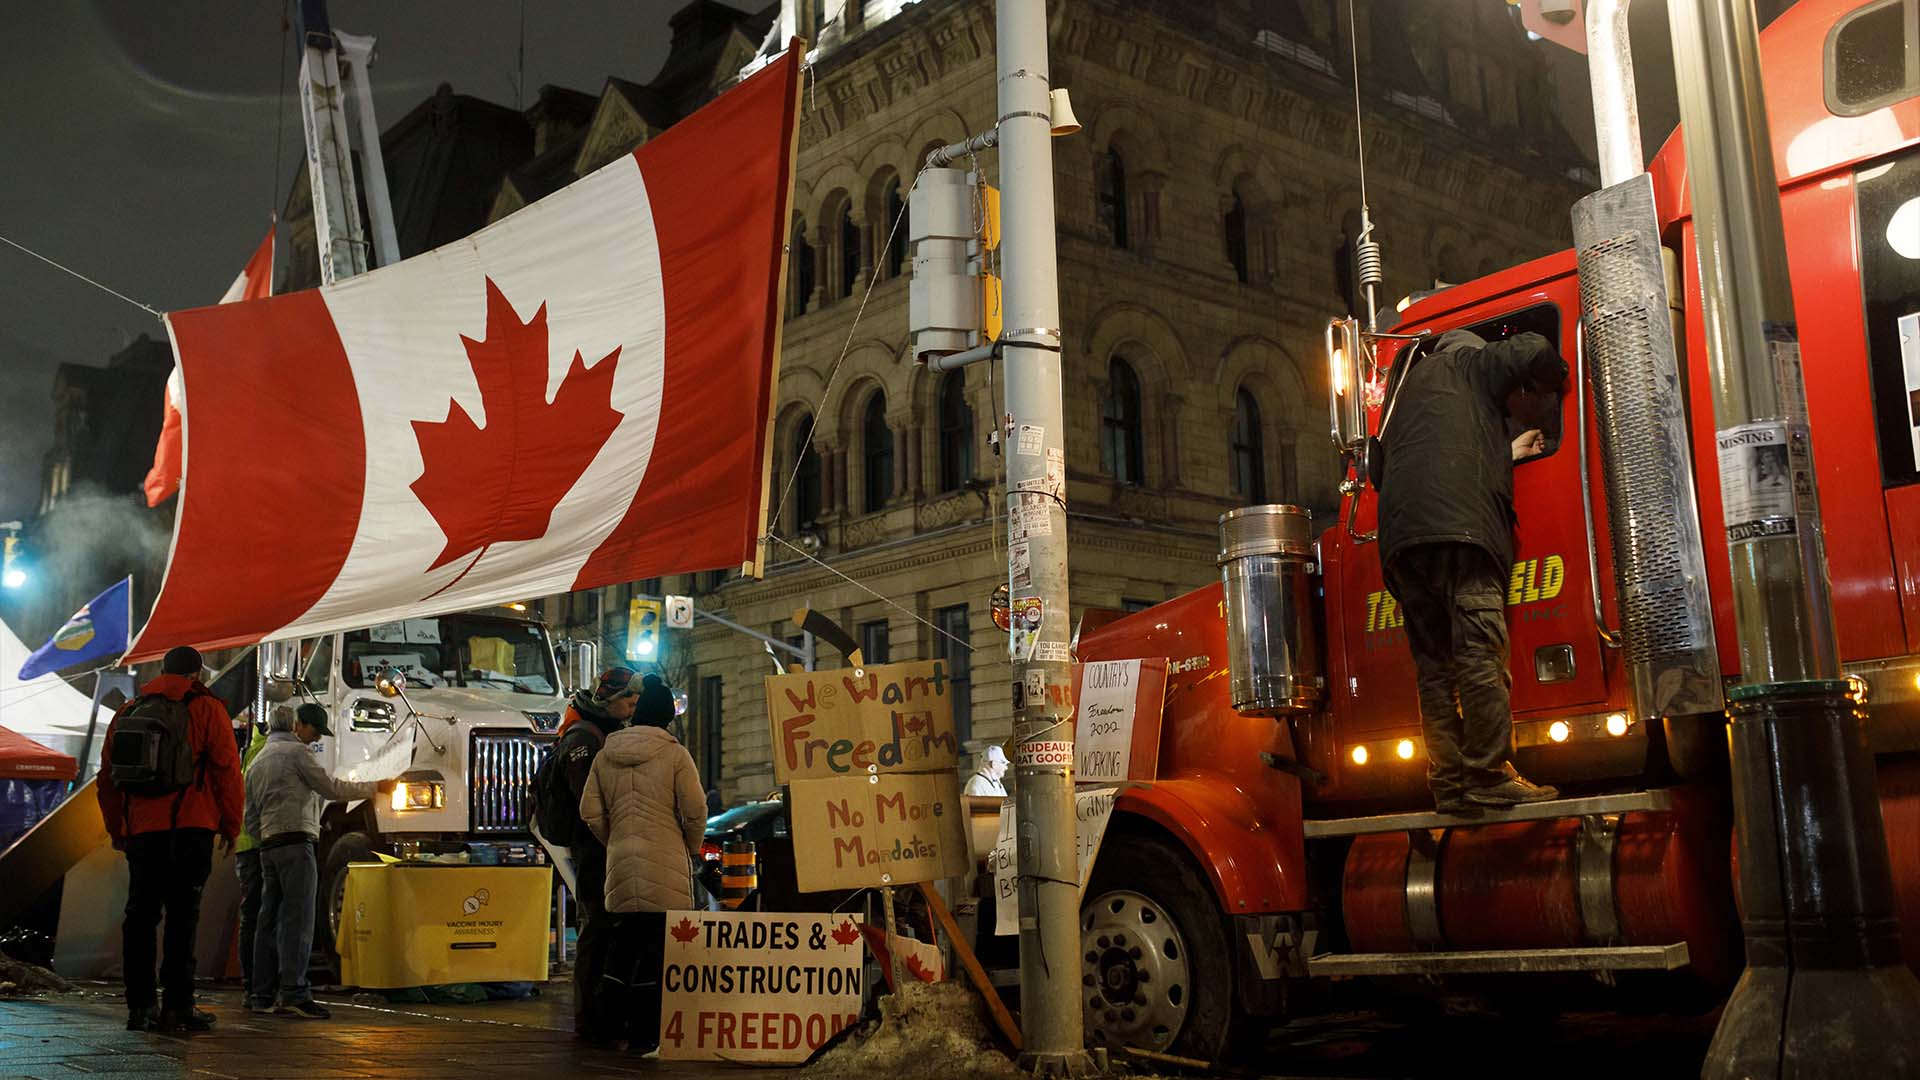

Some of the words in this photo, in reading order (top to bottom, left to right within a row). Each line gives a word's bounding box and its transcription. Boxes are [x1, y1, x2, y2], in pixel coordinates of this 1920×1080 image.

[1719, 430, 1774, 449] MISSING
[785, 680, 837, 713] We
[842, 662, 949, 705] Want
[1088, 663, 1129, 689] COUNTRY'S
[782, 710, 957, 773] Freedom
[1091, 721, 1120, 736] 2022
[1081, 751, 1121, 777] WORKING
[826, 798, 864, 829] No
[875, 792, 943, 824] More
[833, 834, 937, 868] Mandates
[446, 920, 477, 928] VACCINE
[454, 928, 495, 936] AWARENESS
[703, 921, 799, 950] TRADES
[808, 922, 827, 950] &
[665, 964, 860, 995] CONSTRUCTION
[665, 1011, 684, 1048] 4
[698, 1012, 857, 1050] FREEDOM
